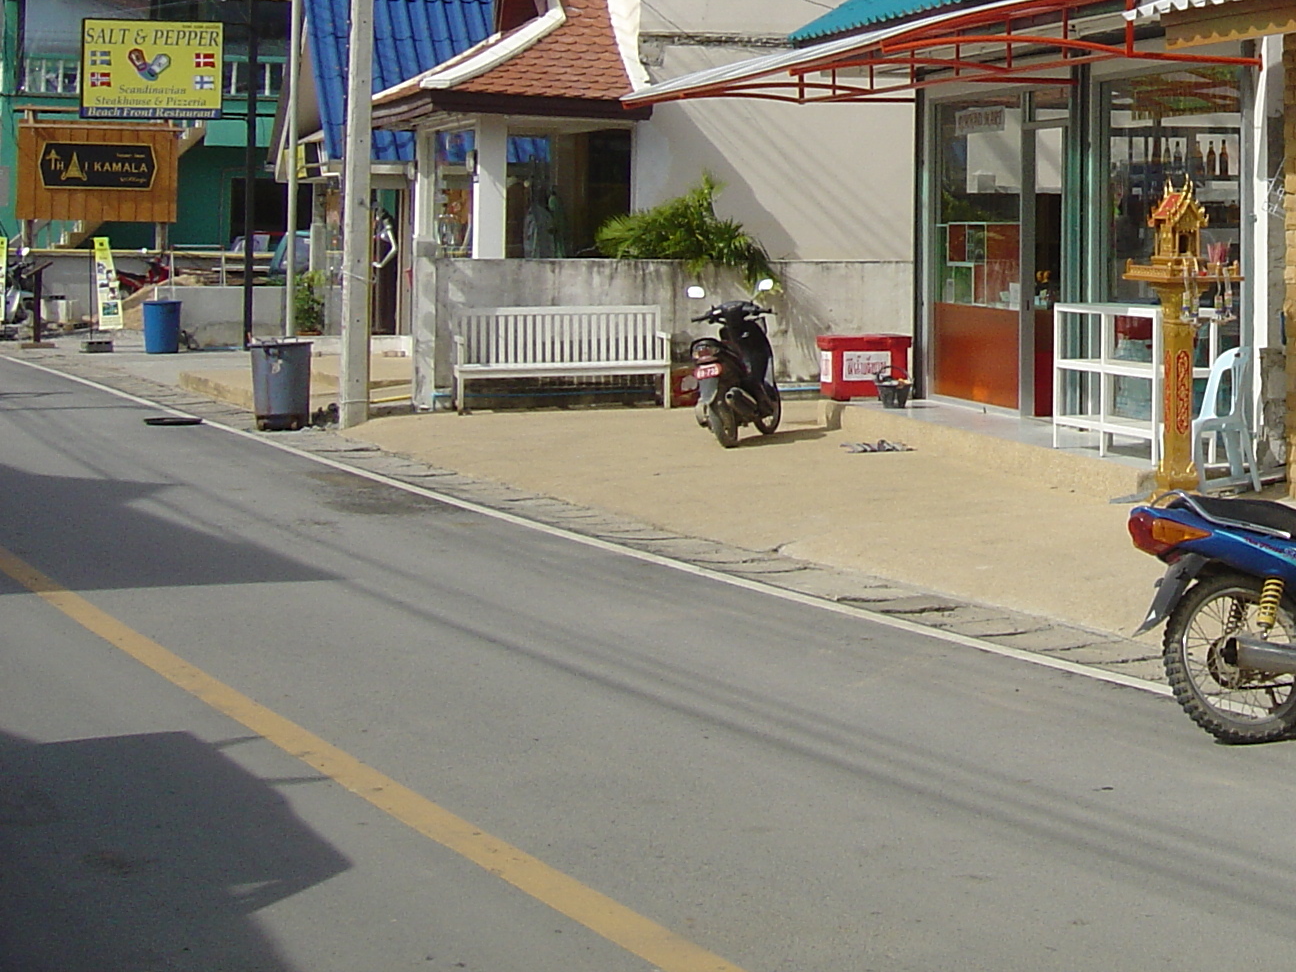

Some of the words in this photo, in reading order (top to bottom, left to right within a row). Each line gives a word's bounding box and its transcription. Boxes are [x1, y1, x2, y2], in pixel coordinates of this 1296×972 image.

[84, 28, 130, 45] SALT
[134, 28, 148, 45] &
[152, 29, 219, 47] PEPPER
[118, 84, 187, 95] Scandinavian
[95, 96, 152, 106] Steakhouse
[154, 97, 163, 106] &
[165, 97, 207, 107] Pizzeria
[87, 107, 121, 117] Beach
[122, 108, 153, 117] Front
[155, 108, 216, 118] Restaurant
[94, 161, 148, 173] KAMALA
